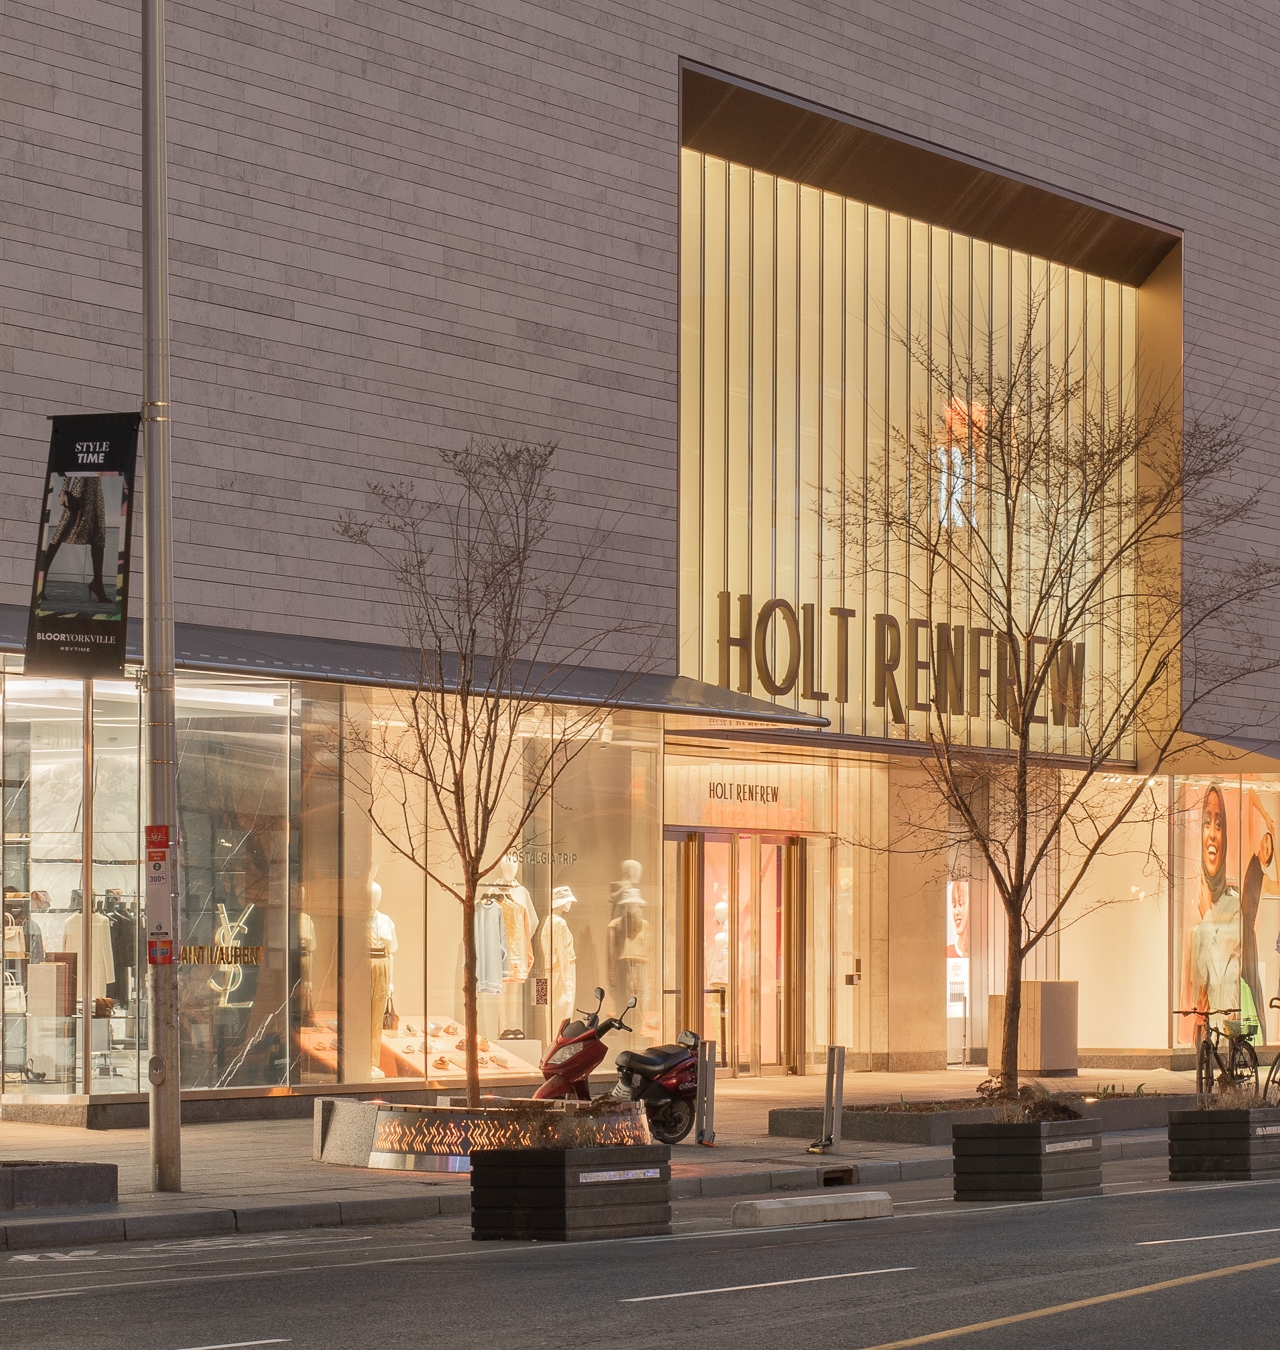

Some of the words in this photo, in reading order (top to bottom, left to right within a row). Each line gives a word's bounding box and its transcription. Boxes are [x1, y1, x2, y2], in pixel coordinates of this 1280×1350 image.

[75, 441, 109, 452] STYLE
[77, 453, 104, 464] TIME
[36, 632, 116, 644] BLOORYORKVILLE
[718, 591, 856, 704] HOLT
[872, 613, 1085, 735] RENFREW
[709, 782, 734, 800] HOLT
[736, 784, 779, 804] RENFREW
[505, 851, 556, 865] NOSTALGIA
[557, 852, 578, 866] TRIP
[149, 875, 162, 883] 300
[180, 945, 208, 965] AINT
[208, 945, 263, 965] LAURENT
